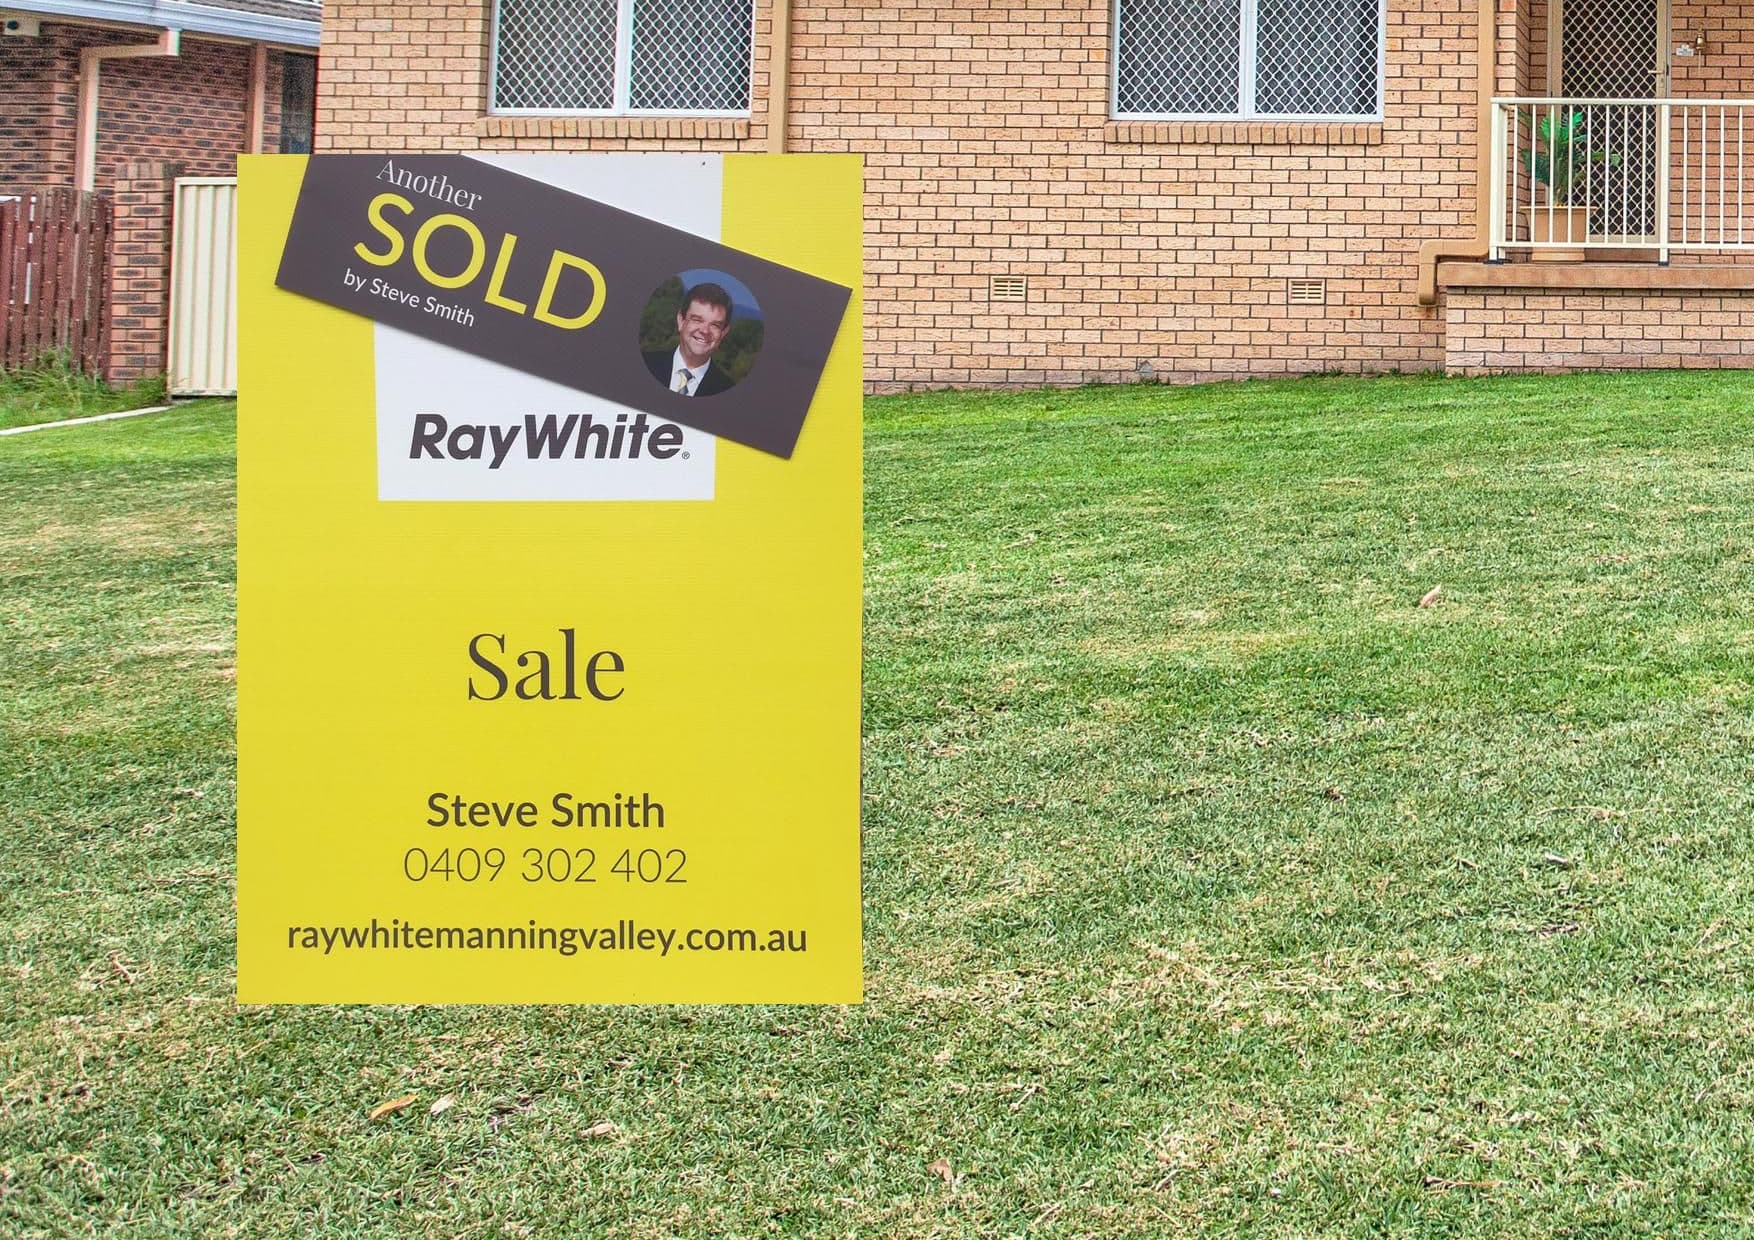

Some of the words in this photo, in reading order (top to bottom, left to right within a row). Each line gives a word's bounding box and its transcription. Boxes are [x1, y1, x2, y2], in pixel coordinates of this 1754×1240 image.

[376, 159, 483, 211] Another
[354, 192, 607, 330] SOLD
[343, 268, 367, 292] by
[370, 278, 420, 308] Steve
[424, 296, 475, 327] Smith
[468, 628, 625, 701] Sale
[426, 792, 538, 828] Steve
[551, 792, 665, 828] Smith
[404, 847, 506, 882] 0409
[521, 847, 597, 883] 302
[610, 848, 688, 884] 402
[288, 918, 807, 957] raywhitemanningvalley.com.au
